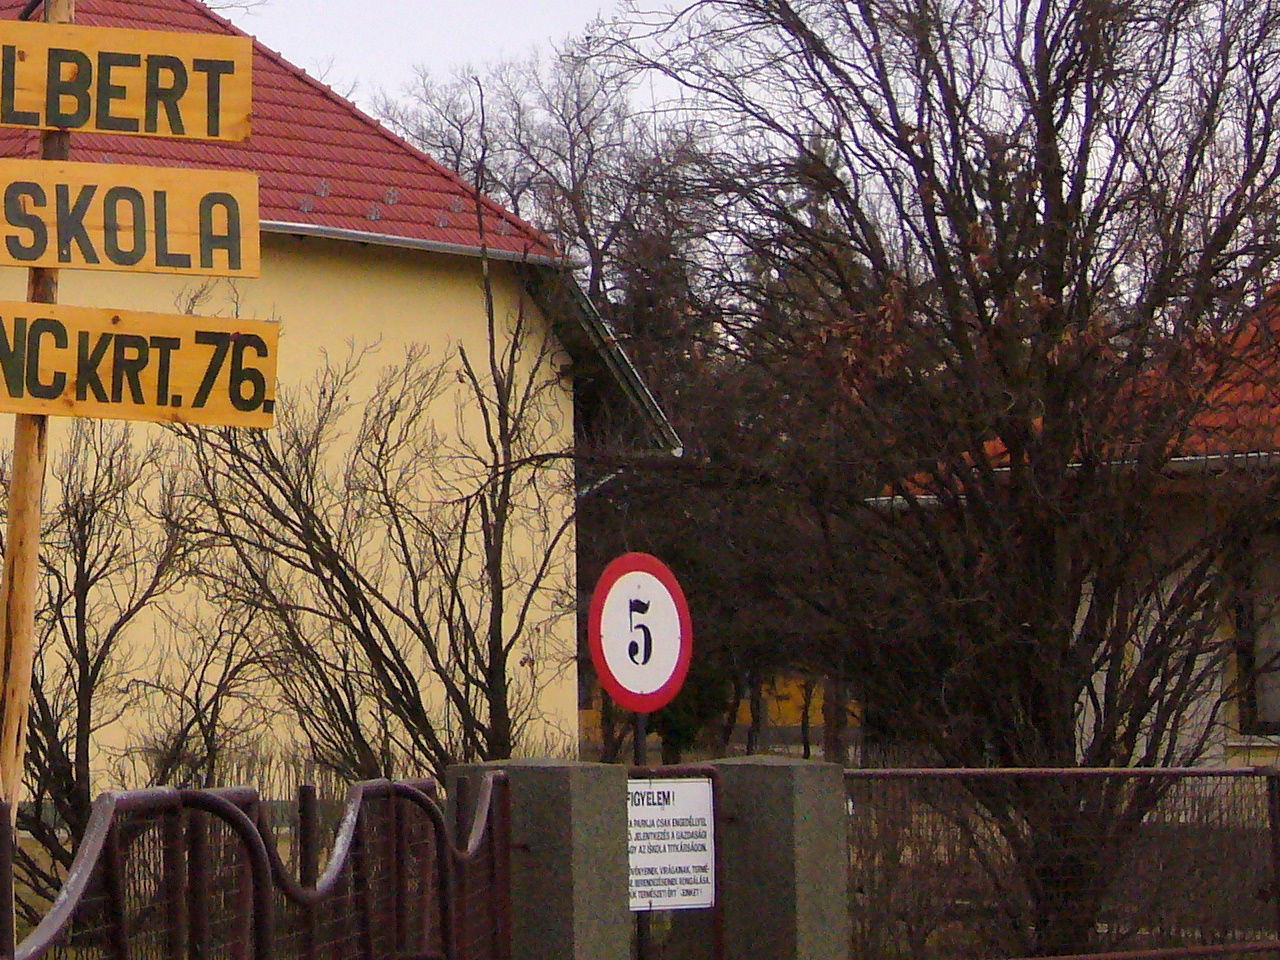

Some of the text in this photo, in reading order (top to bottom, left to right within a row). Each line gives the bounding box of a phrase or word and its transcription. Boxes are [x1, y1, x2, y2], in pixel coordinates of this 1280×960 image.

[75, 330, 183, 408] KRT.
[190, 329, 276, 414] 76.
[628, 598, 653, 666] 5
